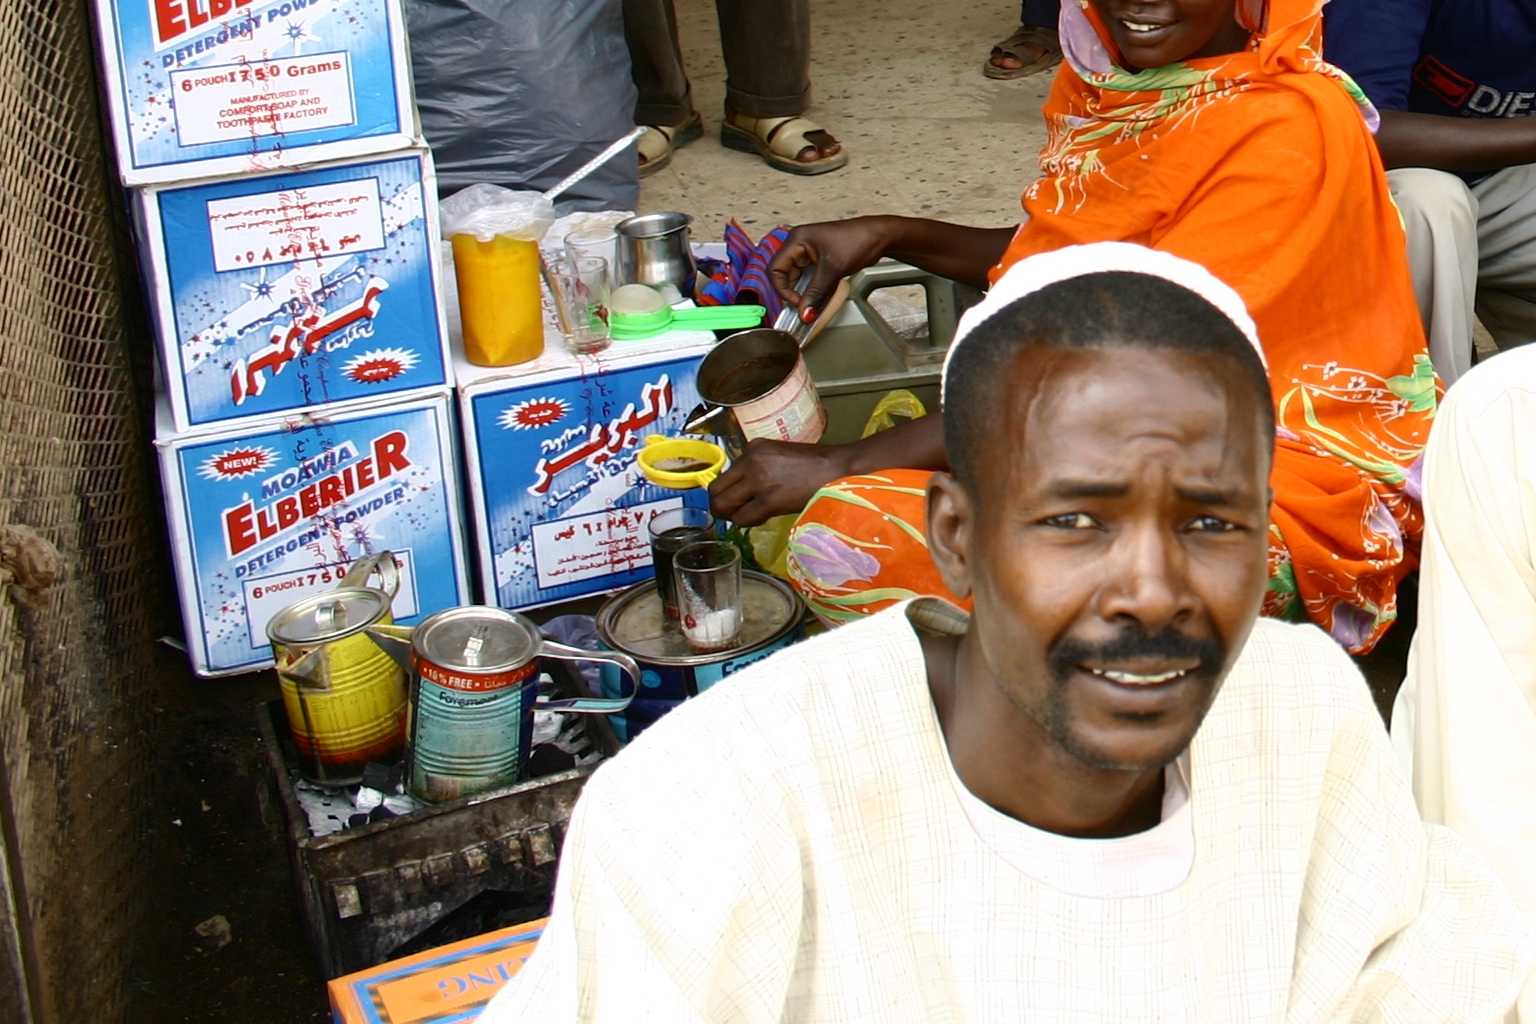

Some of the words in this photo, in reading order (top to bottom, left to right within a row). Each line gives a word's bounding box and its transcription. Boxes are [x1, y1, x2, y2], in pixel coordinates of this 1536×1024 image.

[162, 14, 262, 68] DETERGENT
[181, 79, 193, 92] 6
[194, 74, 228, 88] POUCH
[287, 60, 342, 77] Grams
[219, 105, 269, 118] COMFORT
[271, 100, 298, 111] SOAP
[300, 97, 321, 107] AND
[230, 90, 297, 105] MANUFACTURED
[299, 88, 310, 96] BY
[217, 113, 281, 129] TOOTHPASTE
[284, 107, 328, 121] FACTORY
[223, 456, 257, 470] NEW!
[262, 446, 354, 500] MOAWIA
[226, 432, 412, 556] ELBERIER
[334, 487, 405, 530] POWDER
[252, 587, 263, 600] 6
[265, 580, 296, 595] POUCH
[428, 668, 447, 686] 10%
[448, 676, 473, 689] FREE
